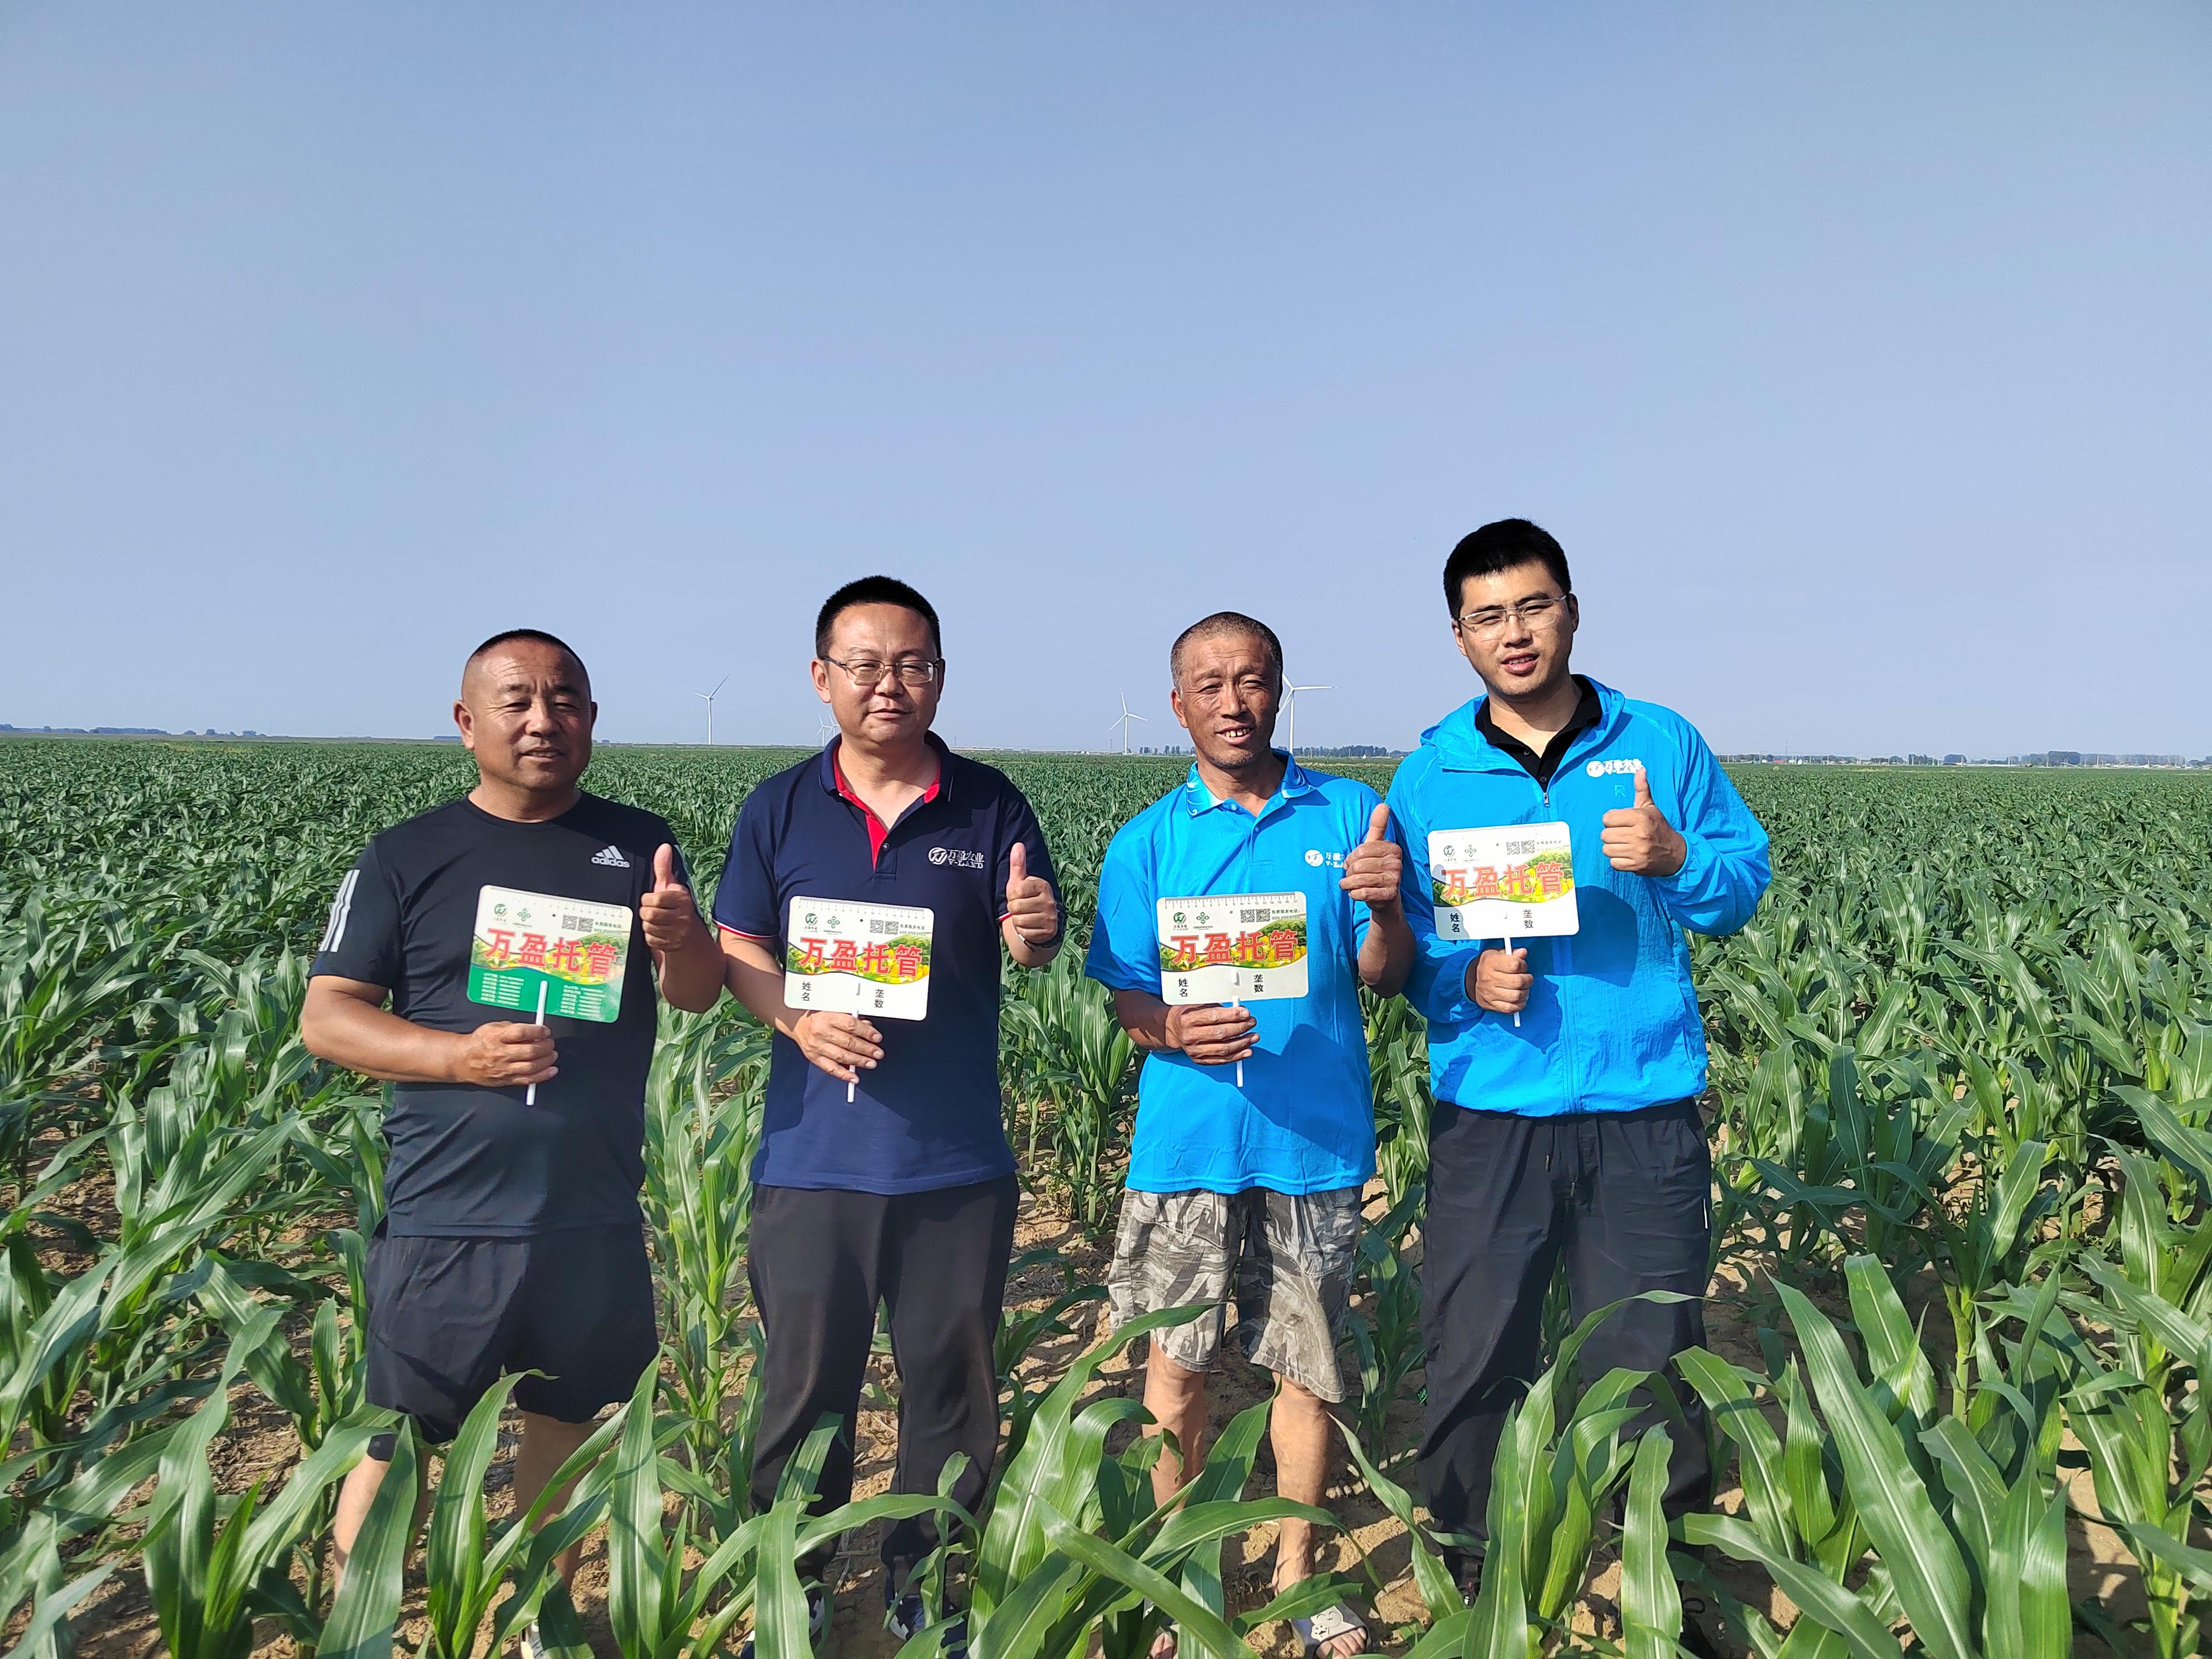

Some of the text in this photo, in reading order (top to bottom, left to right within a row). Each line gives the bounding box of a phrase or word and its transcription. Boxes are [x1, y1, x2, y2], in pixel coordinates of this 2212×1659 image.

[591, 857, 630, 867] adidas
[947, 849, 985, 862] 万盈农业
[947, 859, 984, 869] V-LAND
[1441, 861, 1564, 899] 万盈托管
[1450, 913, 1460, 933] 姓名
[1523, 909, 1533, 929] 垄数
[485, 928, 618, 977] 万盈托管
[1171, 929, 1298, 964] 万盈托管
[799, 937, 922, 977] 万盈托管
[802, 981, 811, 1001] 姓名
[1178, 978, 1189, 997] 姓名
[1253, 974, 1264, 993] 垄数
[874, 989, 884, 1008] 垄数
